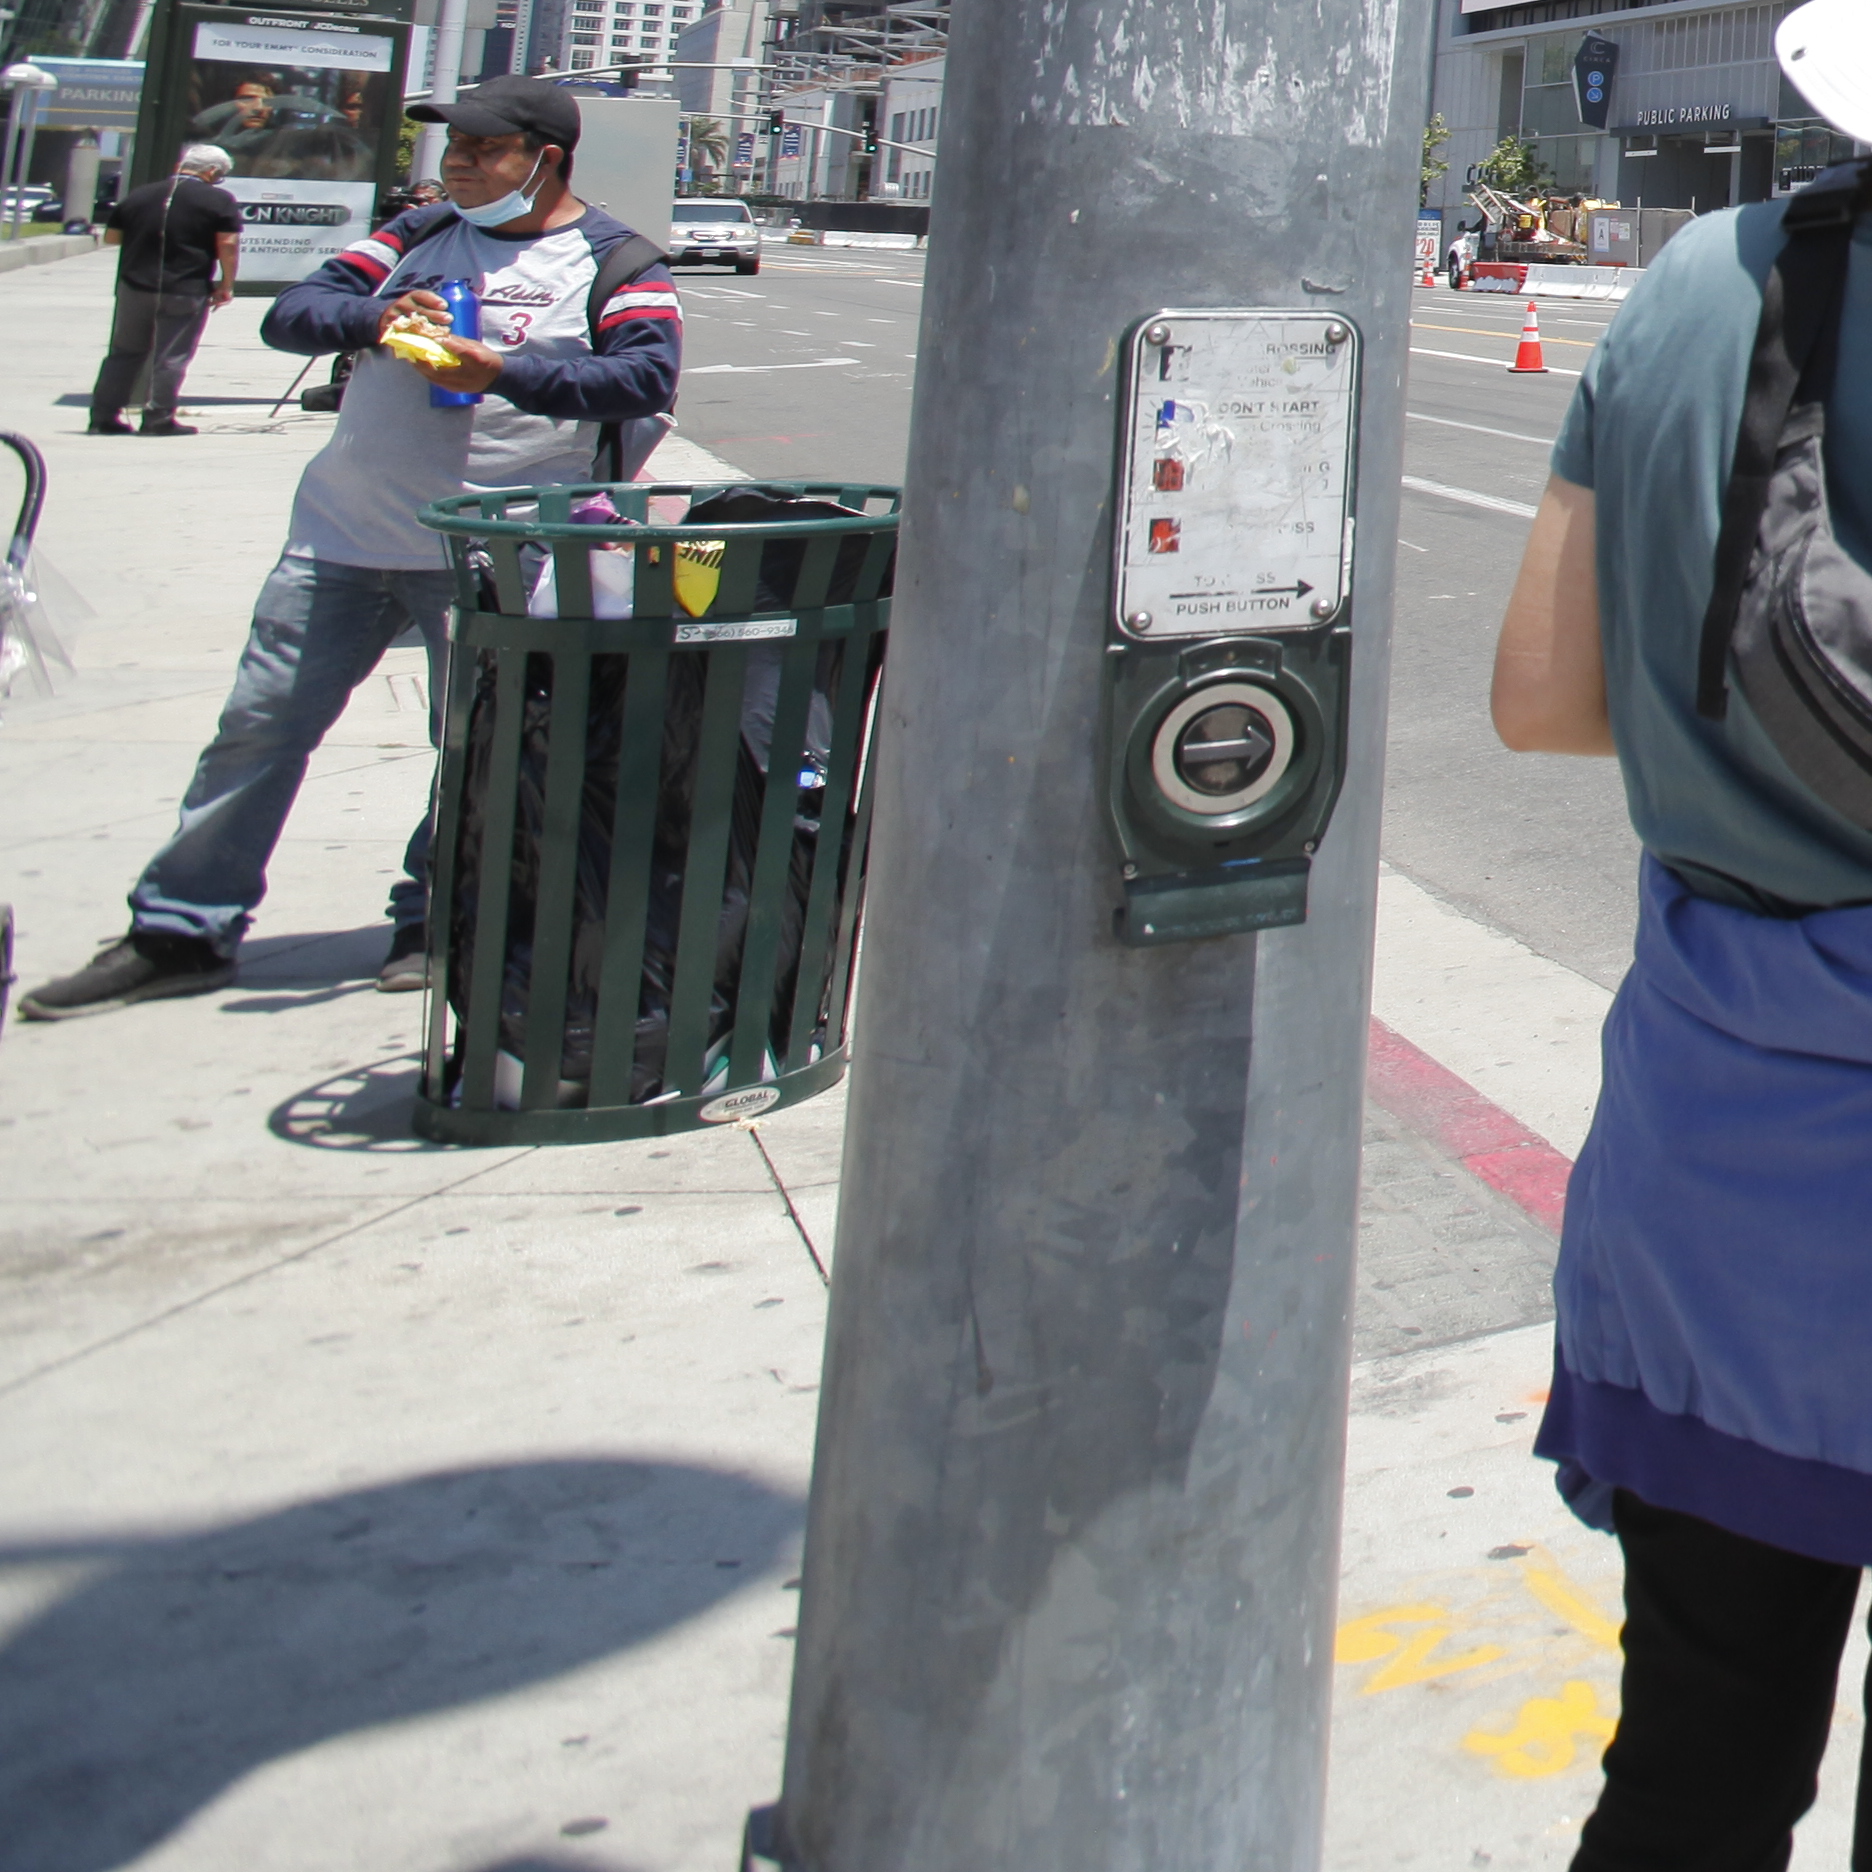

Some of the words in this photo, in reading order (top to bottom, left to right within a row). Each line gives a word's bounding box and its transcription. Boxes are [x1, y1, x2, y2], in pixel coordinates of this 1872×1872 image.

[249, 16, 309, 29] OUTFRONT
[213, 39, 231, 47] FOR
[235, 40, 262, 50] YOUR
[301, 45, 377, 58] CONSIDERATION
[1637, 108, 1675, 125] PUBLIC
[1680, 104, 1730, 123] PARKING
[276, 206, 343, 223] KNIGHT
[240, 238, 311, 246] UTSTANDING
[502, 312, 533, 346] 3
[1264, 343, 1336, 355] ROSSING
[1176, 601, 1220, 615] PUSH
[1226, 598, 1290, 612] BUTTON
[725, 1090, 768, 1107] GLOBAL
